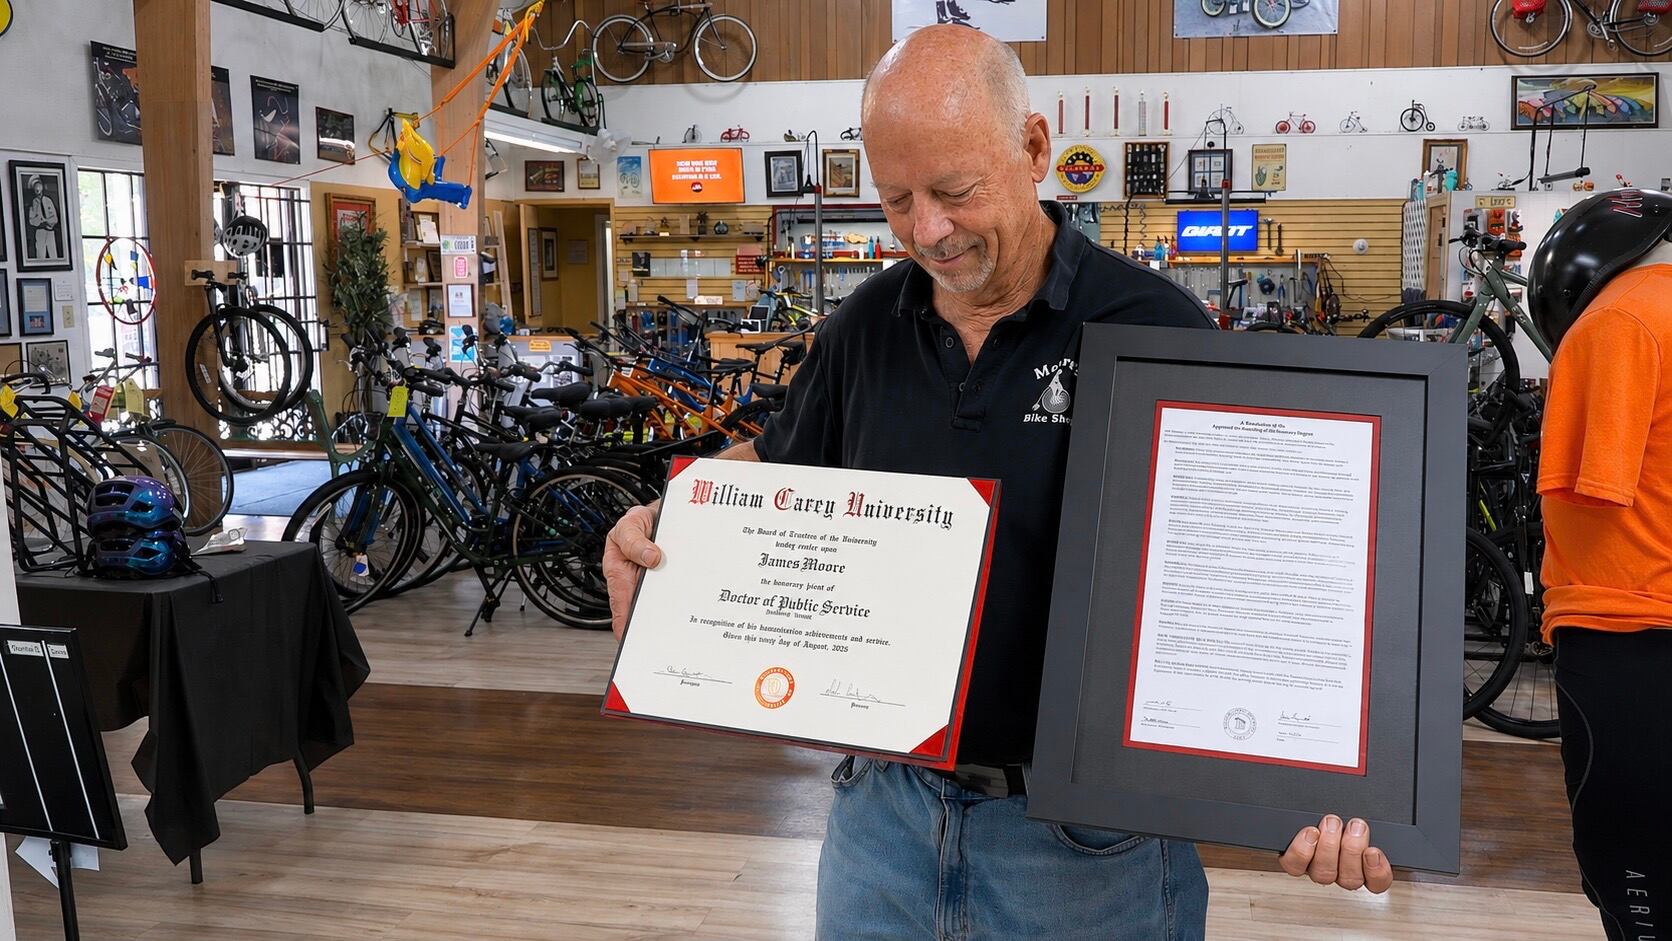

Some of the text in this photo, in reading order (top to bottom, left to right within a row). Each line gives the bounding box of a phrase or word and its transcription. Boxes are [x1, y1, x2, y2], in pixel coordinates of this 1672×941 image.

[1023, 413, 1073, 426] Bike Sho
[688, 479, 954, 530] William Carey University
[742, 526, 754, 535] The
[757, 527, 777, 536] Board
[758, 552, 846, 574] James Moore
[718, 589, 761, 606] Doctor
[762, 594, 777, 607] of
[778, 595, 819, 612] Public
[819, 599, 871, 618] Service
[850, 635, 863, 643] and
